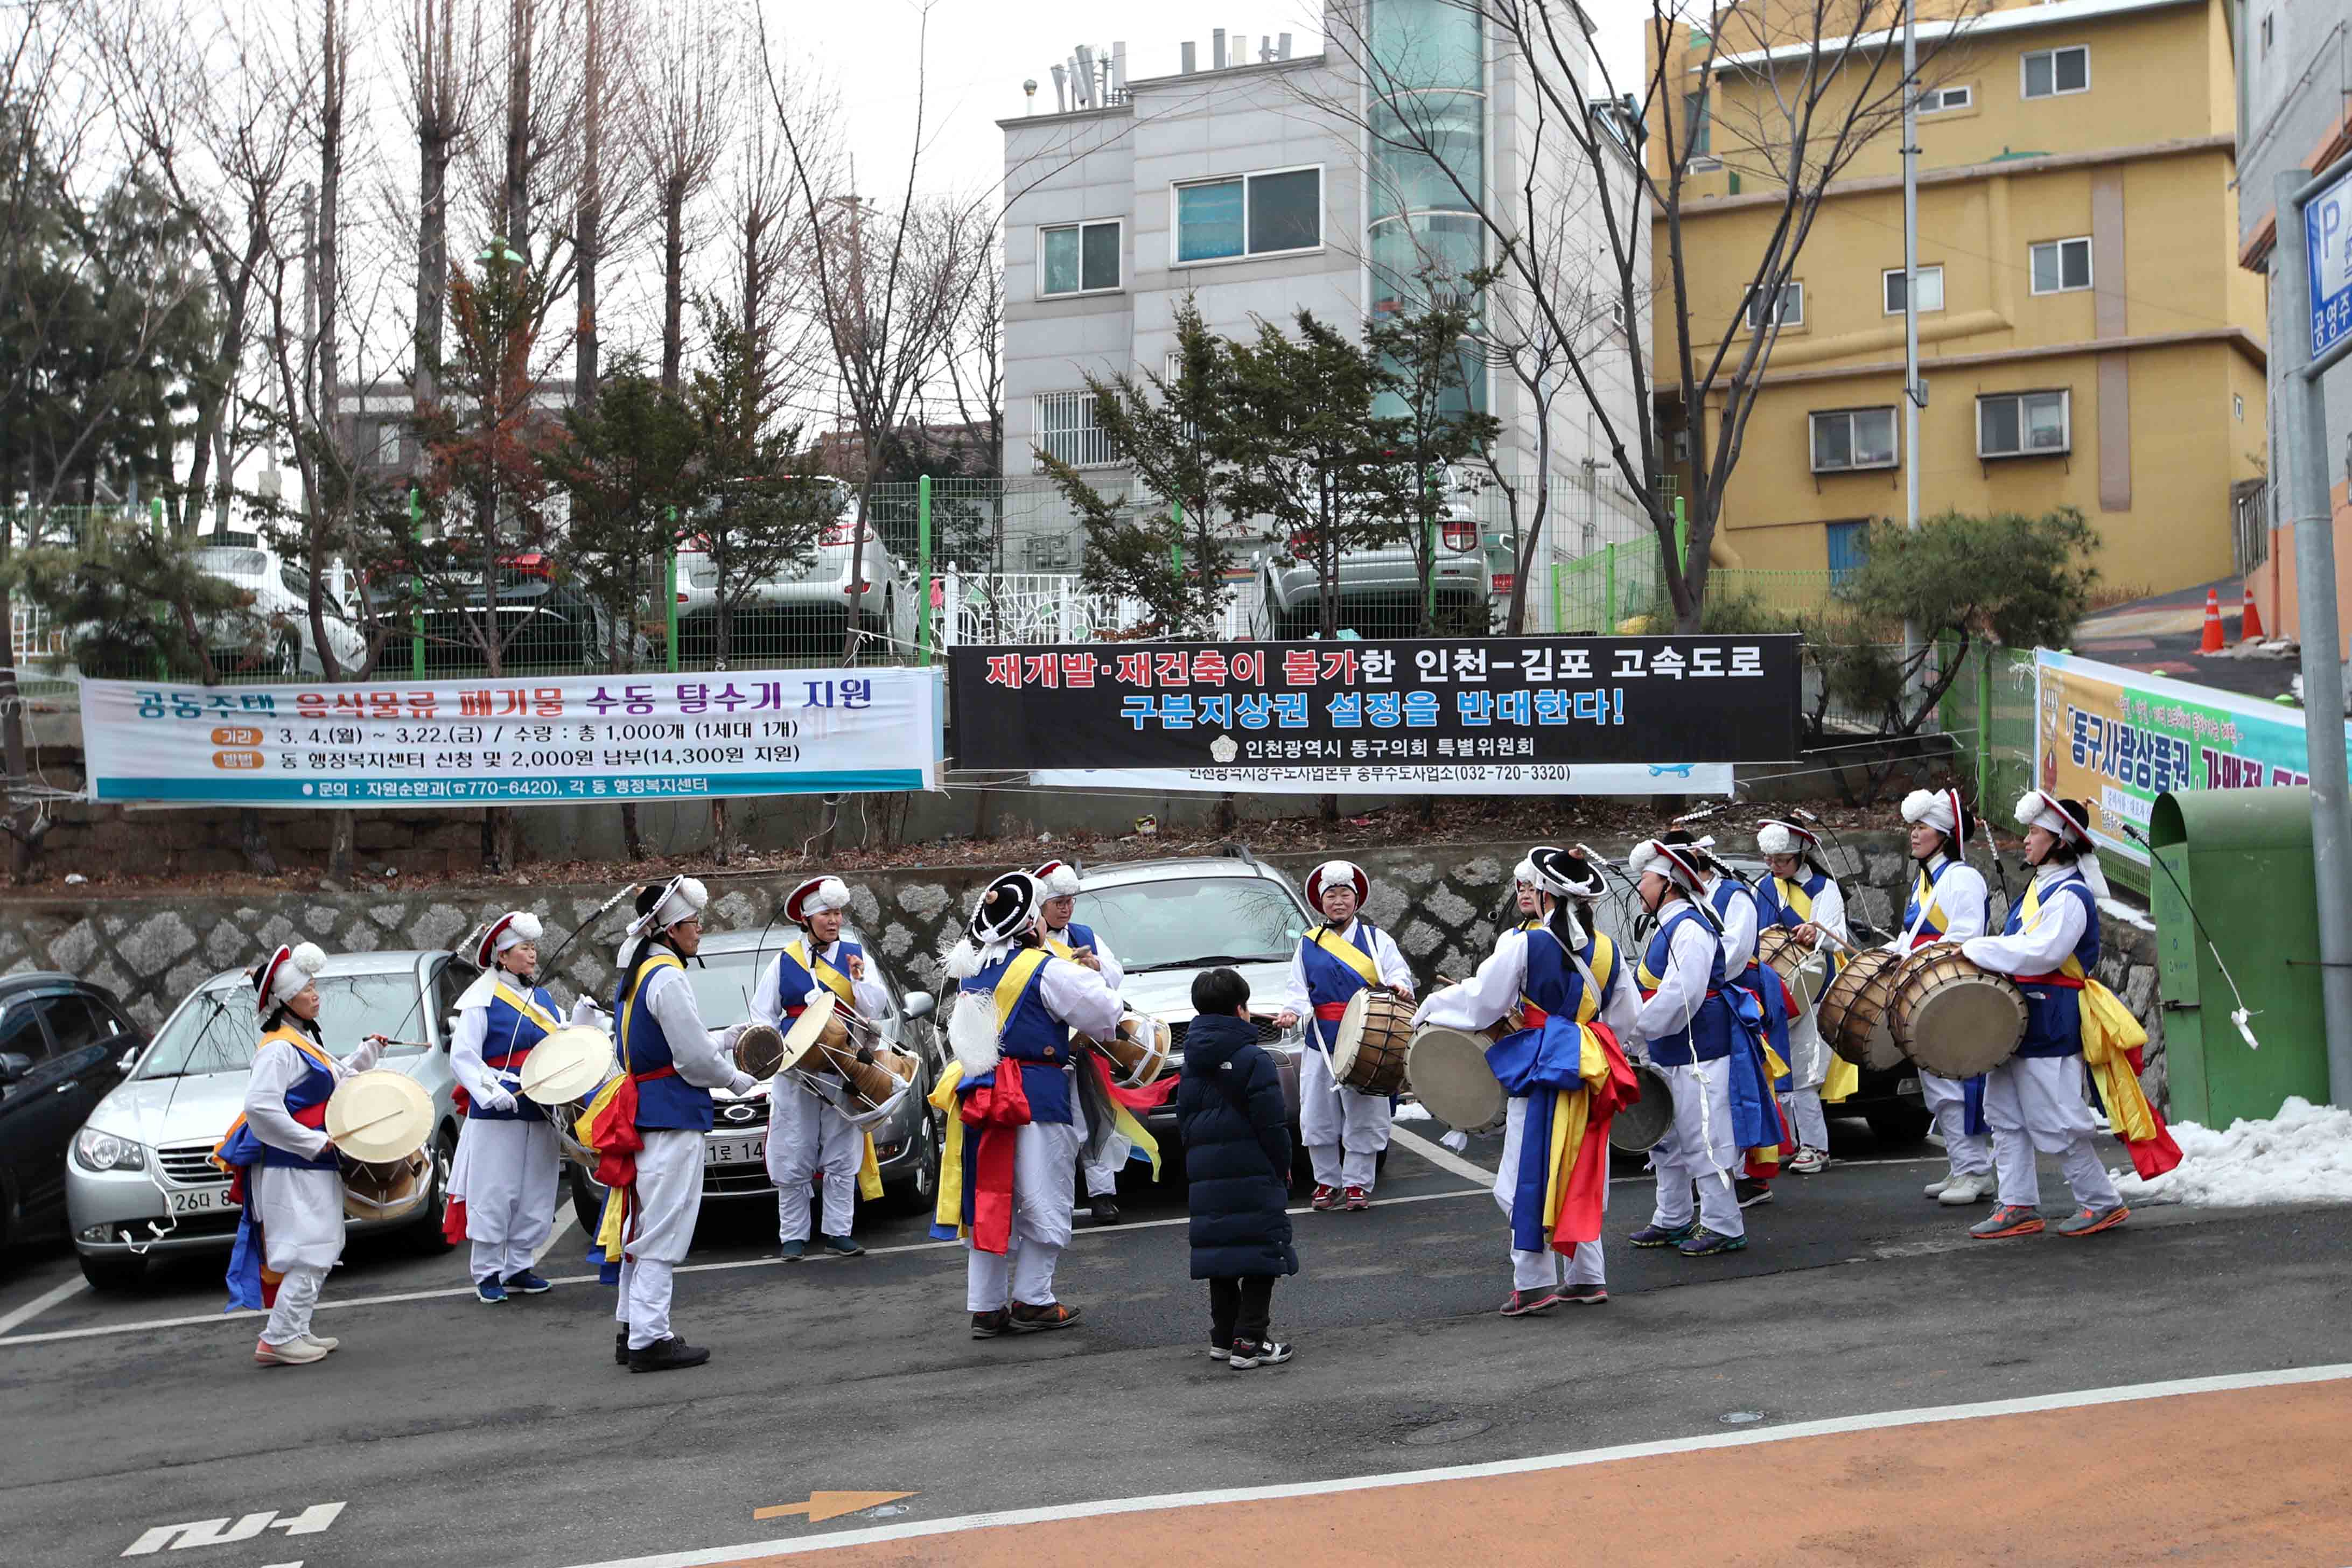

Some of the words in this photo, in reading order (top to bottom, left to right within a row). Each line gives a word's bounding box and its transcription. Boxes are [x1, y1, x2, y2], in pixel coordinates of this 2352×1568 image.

[2323, 200, 2340, 259] P
[986, 650, 1265, 689] 재개발·재건축이
[1283, 649, 1396, 687] 불가한
[1611, 647, 1764, 678] 고속도로
[135, 690, 277, 719] 공동주택
[296, 691, 439, 719] 음식물류
[459, 687, 564, 718] 폐기물
[586, 686, 656, 716] 수동
[676, 681, 781, 713] 탈수기
[802, 678, 872, 709] 지원
[1121, 693, 1308, 730] 구분지상권
[1326, 691, 1440, 728] 설정을
[1458, 688, 1625, 726] 반대한다!
[222, 730, 251, 744] 기간
[280, 729, 298, 744] 3.
[396, 726, 482, 744] 3.22.(금)
[514, 725, 554, 741] 수량
[578, 724, 595, 741] 총
[606, 723, 684, 741] 1,000개
[696, 722, 752, 740] (1세대
[762, 721, 799, 739] 1개)
[280, 753, 296, 769] 동
[309, 751, 425, 769] 행정복지센터
[435, 751, 472, 769] 신청
[483, 751, 502, 768] 및
[512, 750, 594, 767] 2,000원
[604, 748, 744, 766] 납부(14,300원
[755, 747, 800, 764] 지원)
[1245, 740, 1342, 759] 인천광역시
[1349, 739, 1429, 758] 동구의회
[1436, 738, 1534, 757] 특별위원회
[318, 781, 349, 796] 문의
[569, 779, 584, 794] 각
[592, 780, 606, 794] 동
[614, 777, 708, 792] 행정복지센터
